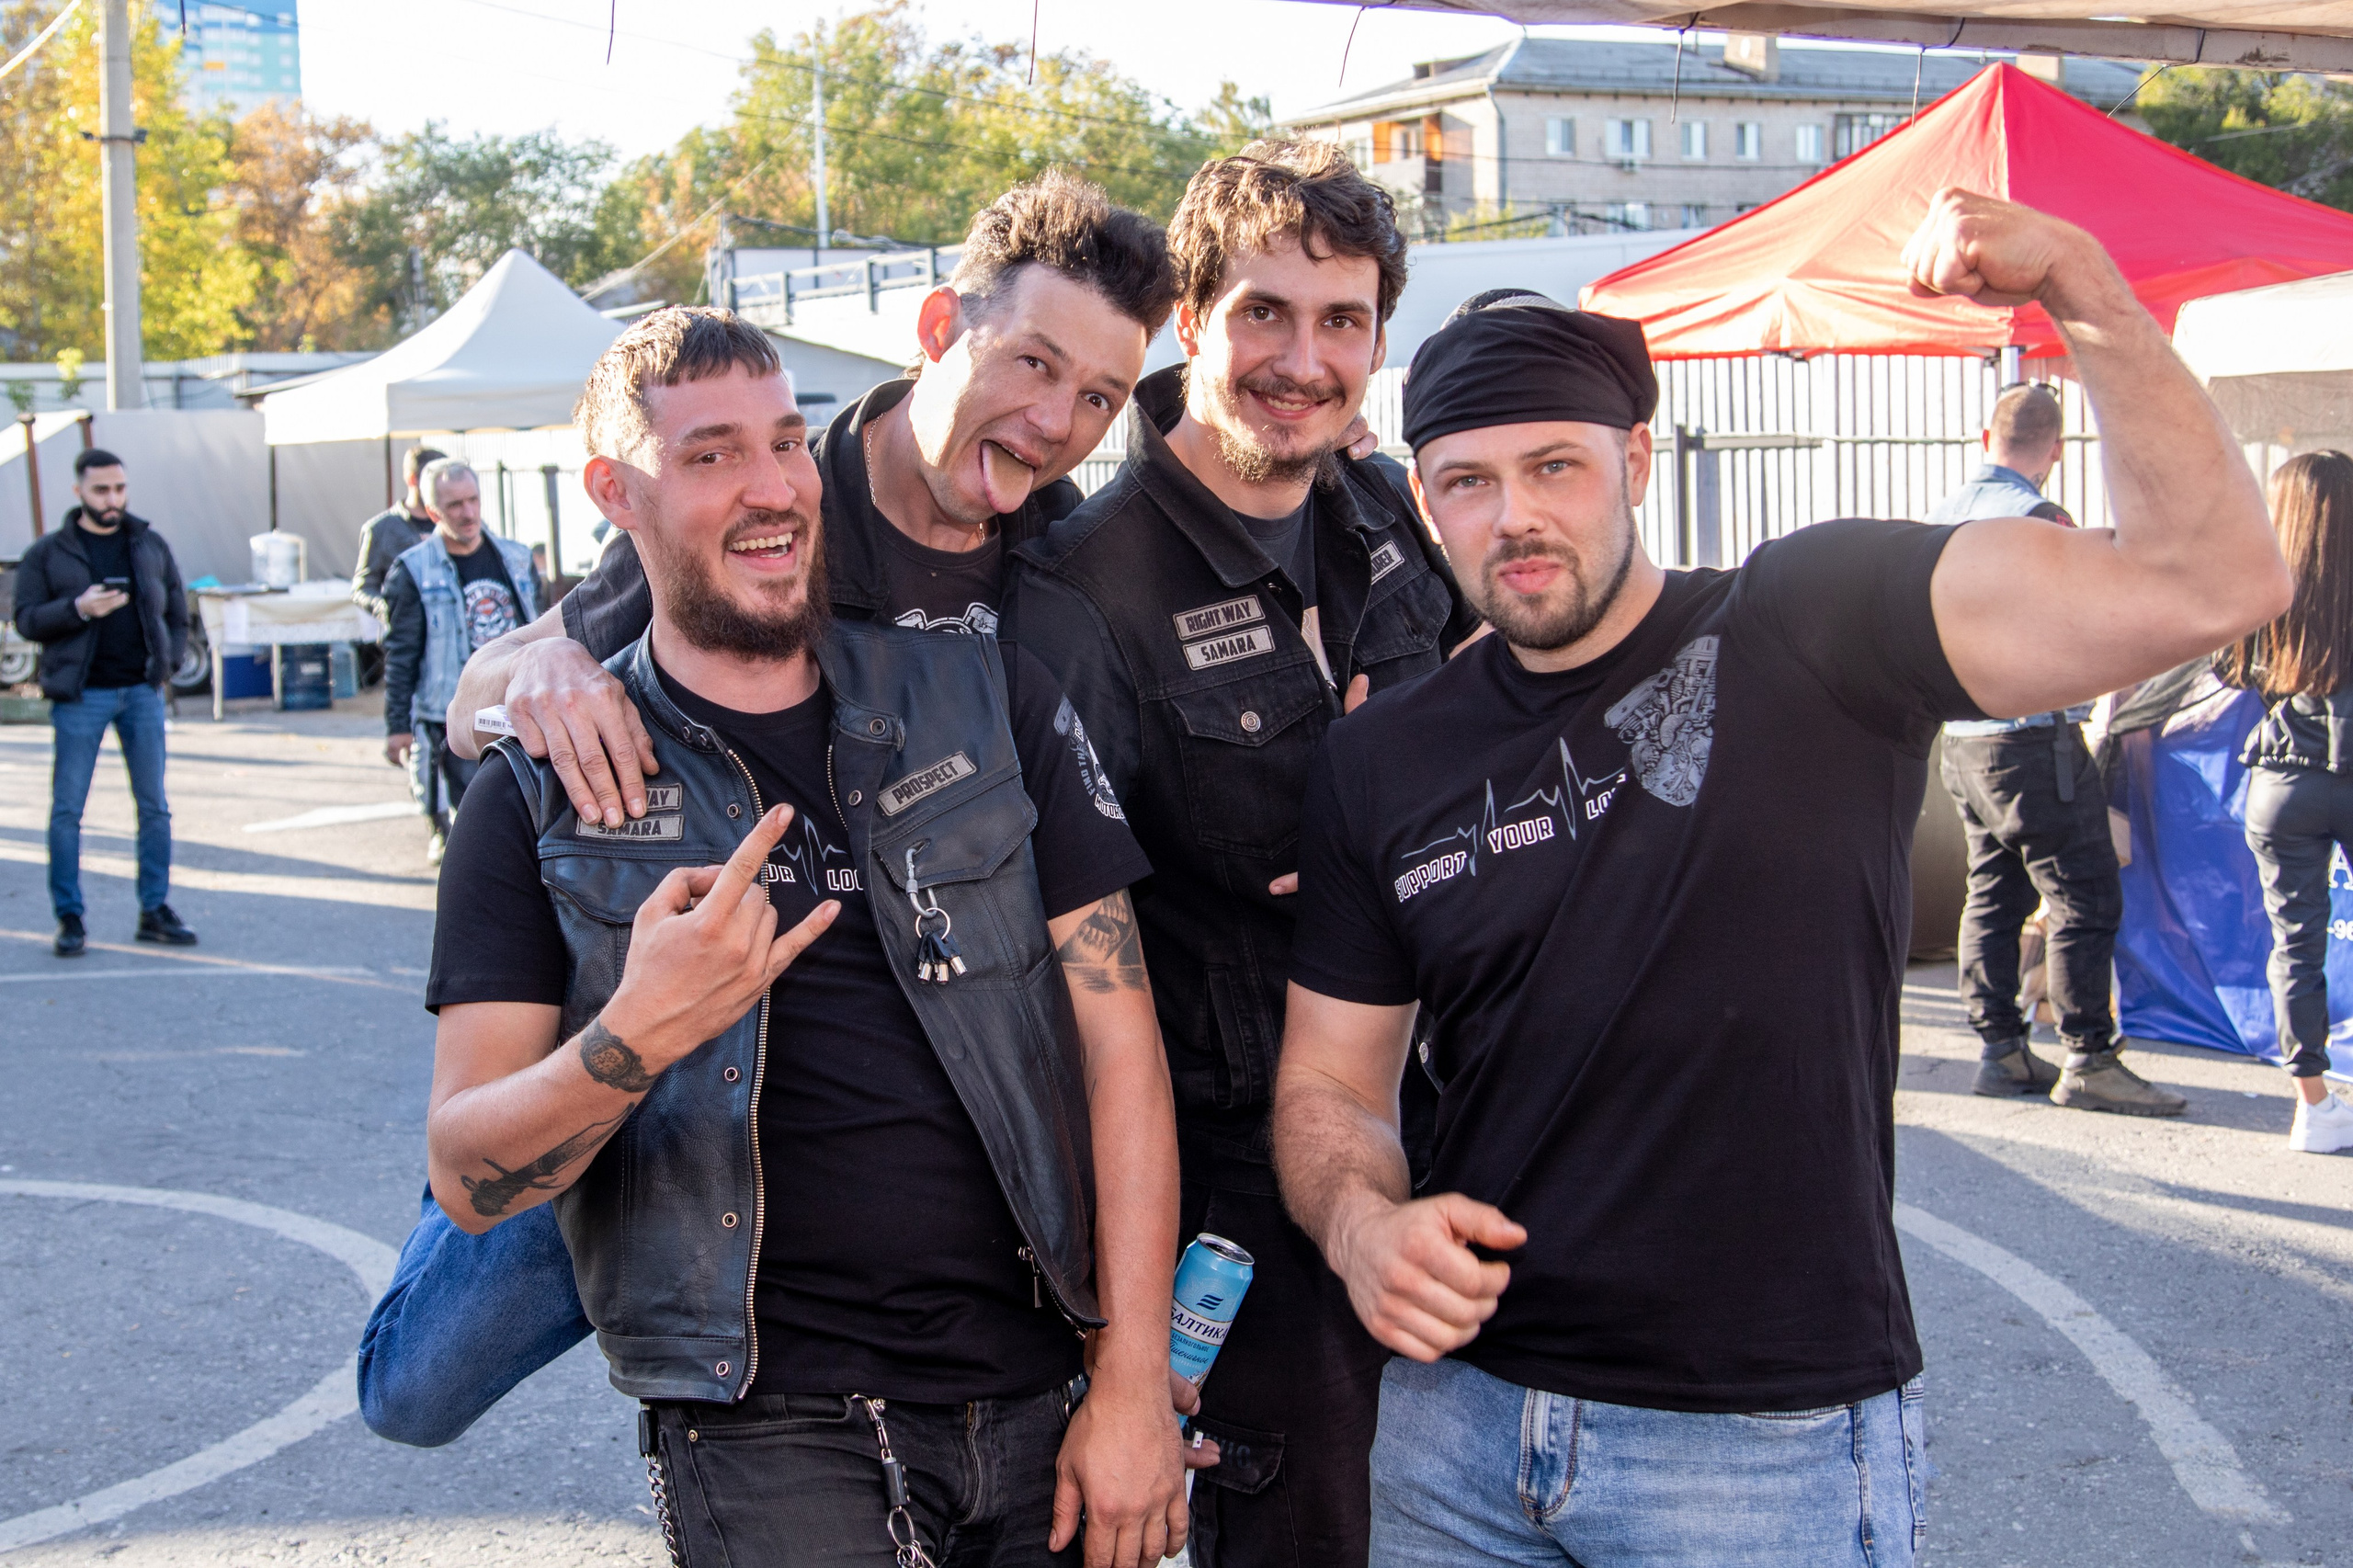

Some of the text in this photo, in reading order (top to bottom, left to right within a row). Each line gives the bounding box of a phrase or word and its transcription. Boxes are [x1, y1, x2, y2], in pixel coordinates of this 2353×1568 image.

[1370, 549, 1395, 577] URER
[1185, 601, 1252, 633] RIGHT WAY
[1200, 634, 1256, 662] SAMARA
[1076, 750, 1086, 767] TH
[892, 761, 959, 804] PROSPECT
[1080, 768, 1097, 797] FIND
[767, 863, 797, 883] UR
[1394, 851, 1467, 903] SUPPORT
[1486, 815, 1555, 854] YOUR
[1170, 1306, 1229, 1340] БАЛТИКА
[1171, 1332, 1211, 1353] БЕЗАЛКОГОЛЬНОЕ
